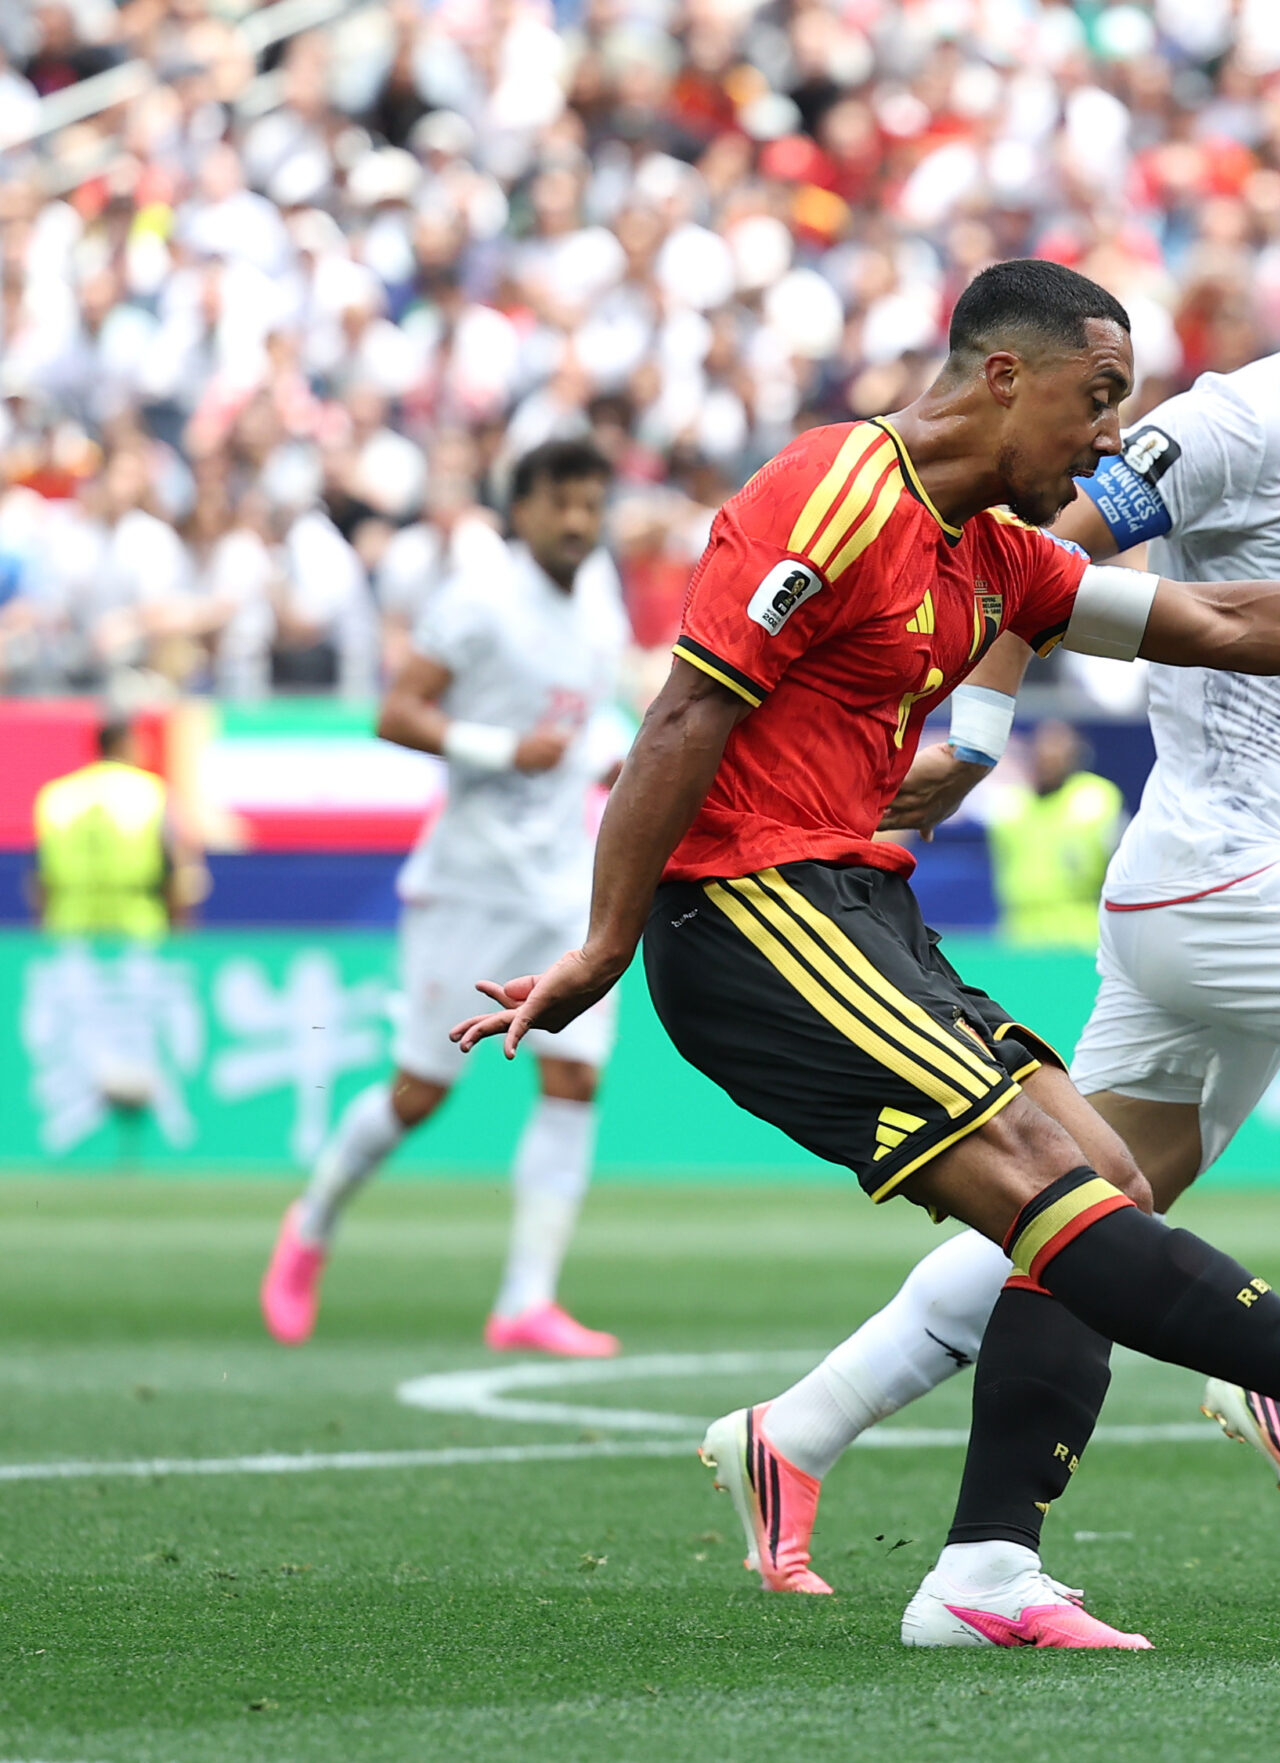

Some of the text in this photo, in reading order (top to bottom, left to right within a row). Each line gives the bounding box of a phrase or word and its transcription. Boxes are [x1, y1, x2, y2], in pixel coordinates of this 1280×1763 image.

[1097, 471, 1116, 495] the
[1113, 491, 1144, 533] World
[1099, 497, 1119, 523] FIFA
[1109, 461, 1156, 520] UNITES
